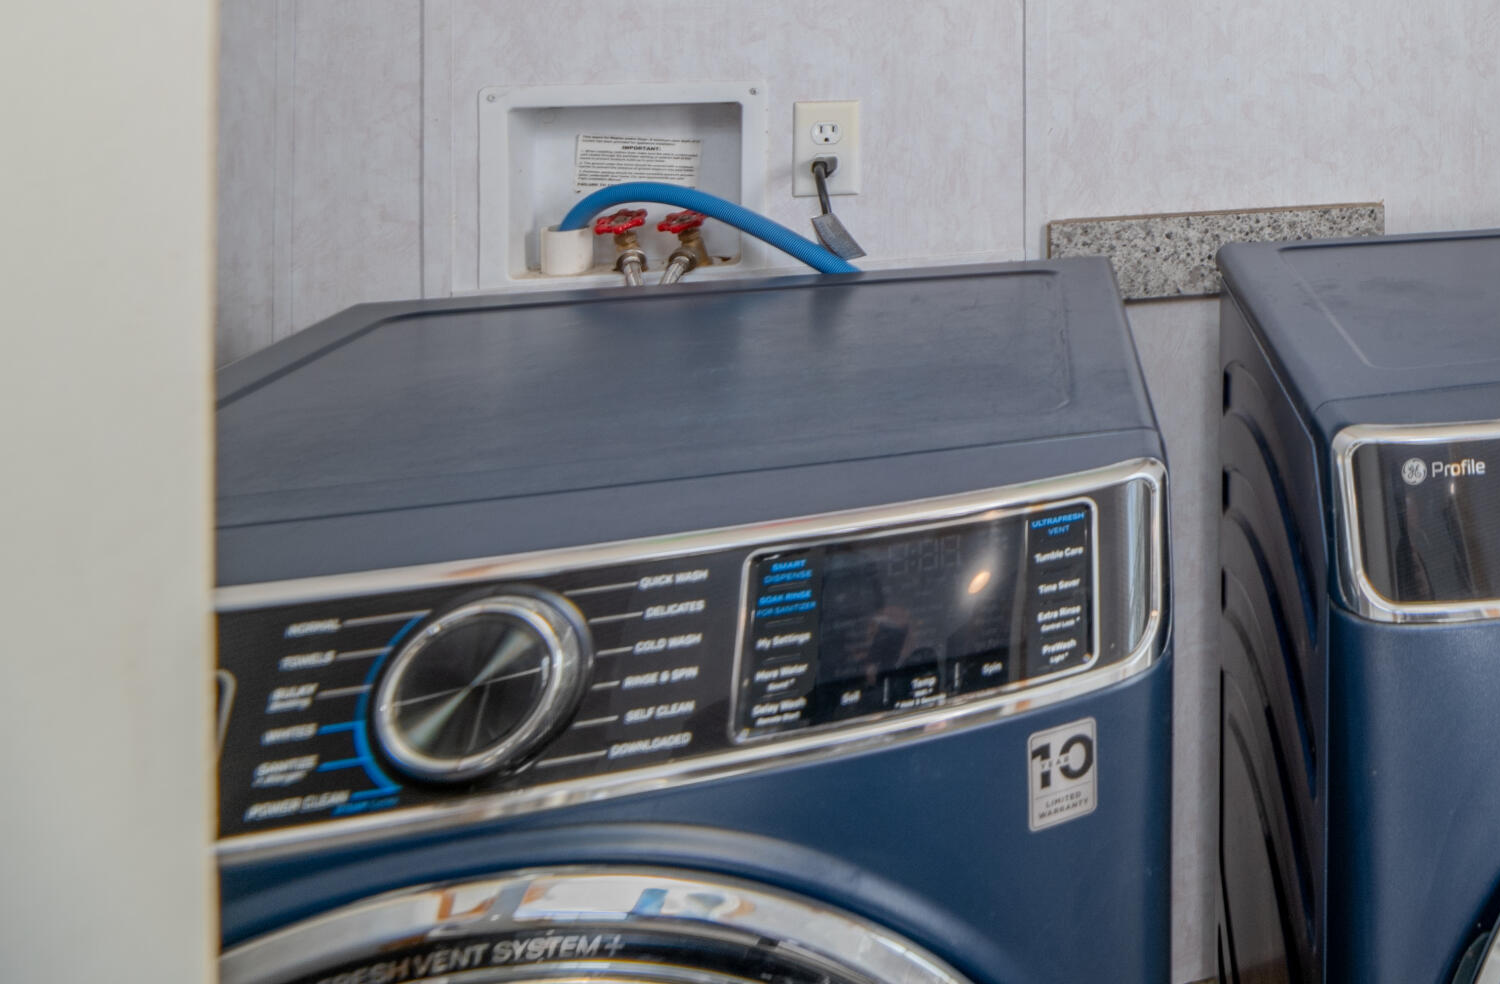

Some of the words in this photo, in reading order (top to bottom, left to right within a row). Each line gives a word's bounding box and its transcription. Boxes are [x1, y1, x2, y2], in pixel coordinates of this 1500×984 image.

[1431, 458, 1486, 478] Profile
[1031, 512, 1085, 530] ULTRAFRESH
[1048, 525, 1071, 537] VENT
[1034, 550, 1064, 564] Tumble
[1064, 546, 1084, 558] Care
[771, 559, 807, 573] SMART
[639, 574, 674, 591] QUICK
[674, 569, 709, 585] WASH
[1038, 583, 1058, 595] Time
[1058, 578, 1081, 591] Saver
[644, 599, 705, 620] DELICATES
[1037, 610, 1059, 623] Extra
[1059, 605, 1082, 617] Rinse
[633, 638, 667, 655] COLD
[667, 633, 702, 650] WASH
[772, 632, 811, 649] Settings
[279, 650, 337, 671] TOWELS
[981, 661, 1003, 677] Spin
[622, 672, 659, 690] RINSE
[670, 666, 698, 683] SPIN
[624, 706, 655, 725] SELF
[655, 700, 695, 719] CLEAN
[608, 732, 692, 759] DOWNLOADED
[1031, 733, 1094, 790] 10
[1041, 756, 1069, 770] YEAR
[1039, 798, 1089, 819] WARRANTY
[1045, 790, 1082, 808] LIMITED
[411, 942, 489, 974] VENT
